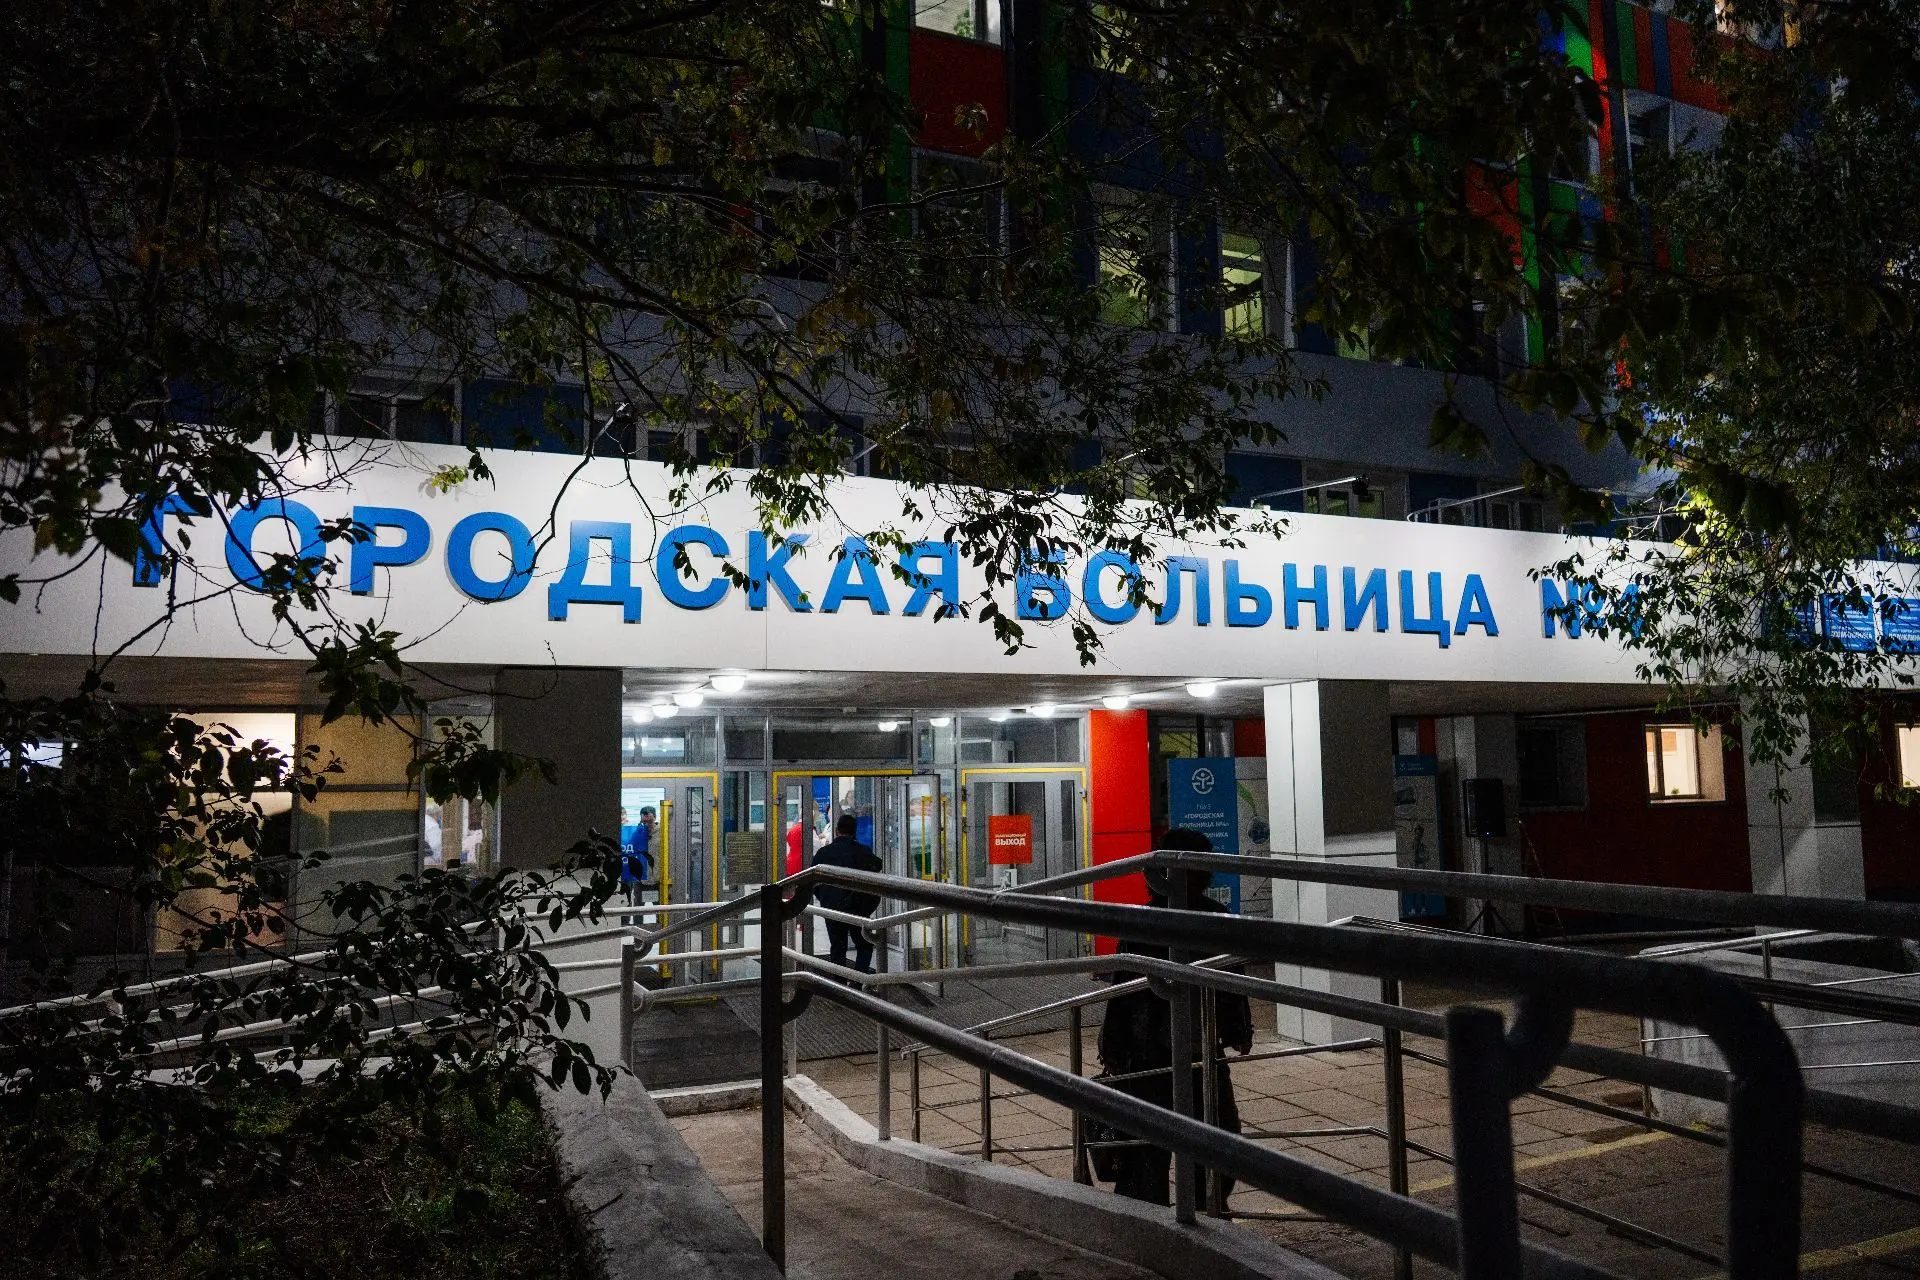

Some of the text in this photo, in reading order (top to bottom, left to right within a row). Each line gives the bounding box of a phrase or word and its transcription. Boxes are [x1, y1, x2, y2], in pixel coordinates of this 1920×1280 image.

[132, 493, 959, 622] ГОРОДСКАЯ
[1014, 545, 1499, 649] БОЛЬНИЦА
[995, 838, 1026, 846] ВЫХОД
